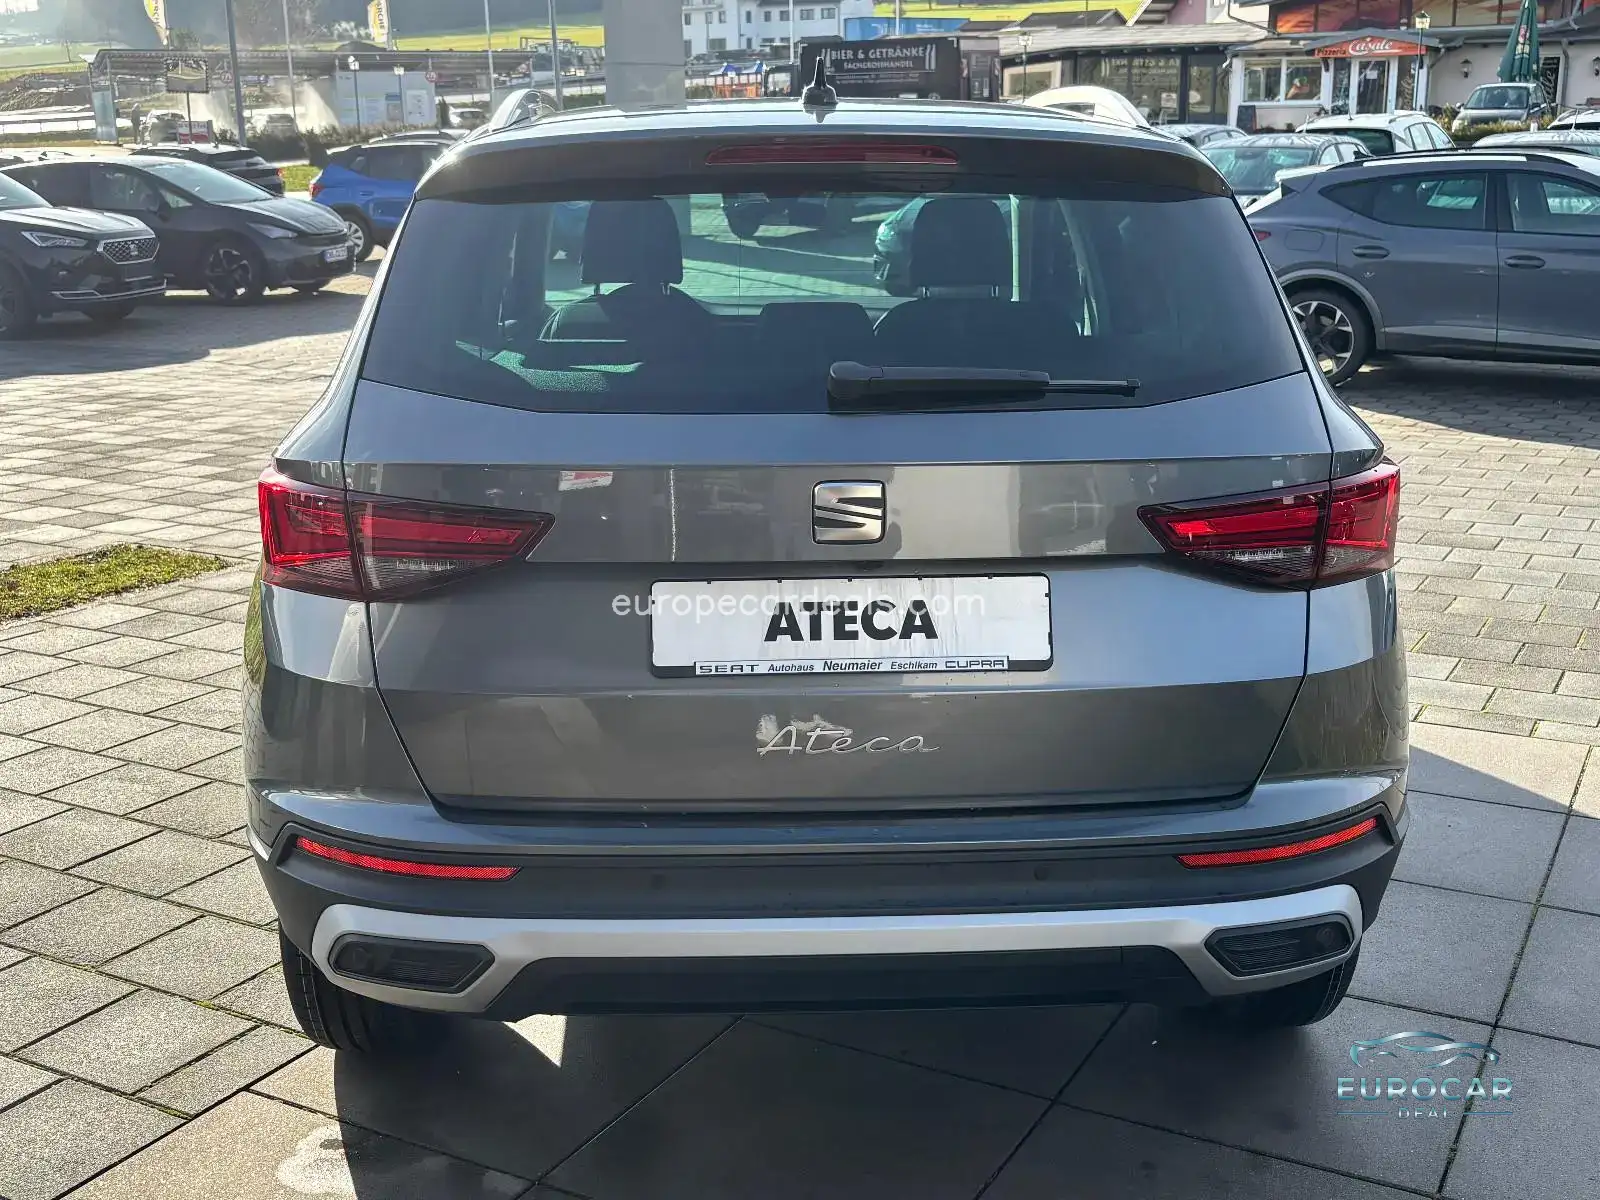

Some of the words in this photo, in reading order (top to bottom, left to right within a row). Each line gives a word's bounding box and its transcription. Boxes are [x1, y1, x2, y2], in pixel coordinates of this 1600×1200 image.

[831, 48, 854, 60] BIER
[857, 47, 865, 59] &
[868, 45, 925, 59] GETRÄNKE
[764, 599, 939, 642] ATECA
[699, 664, 760, 674] SEAT
[768, 663, 815, 673] Autohaus
[822, 659, 883, 672] Neumaier
[890, 660, 938, 670] Eschlkam
[945, 659, 1005, 669] CUPRA
[756, 724, 940, 757] Ateca
